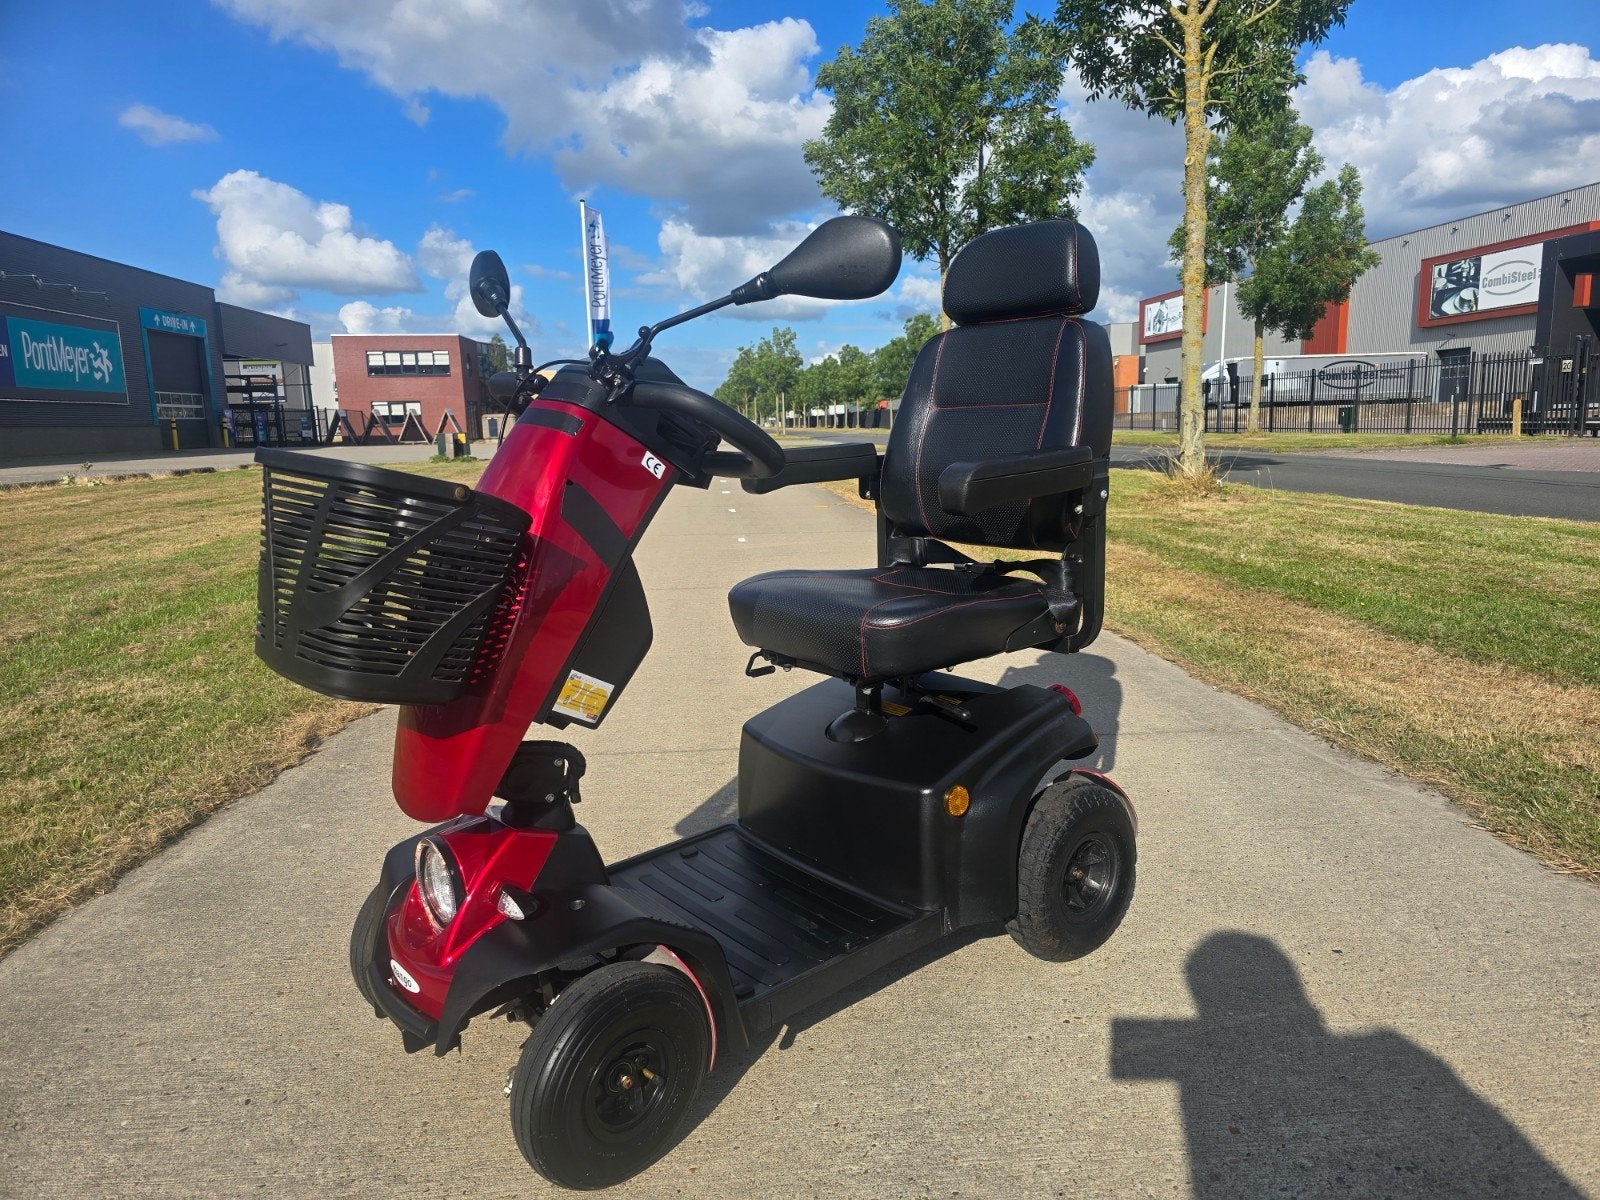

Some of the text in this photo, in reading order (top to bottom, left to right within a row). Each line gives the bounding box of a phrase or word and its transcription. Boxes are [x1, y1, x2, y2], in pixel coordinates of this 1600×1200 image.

[591, 243, 608, 308] PontMeyer
[1482, 268, 1537, 288] CombiSteel
[162, 315, 189, 330] DRIVE-IN
[21, 331, 90, 382] PontMeyer
[1318, 369, 1378, 381] CombiSteel
[646, 456, 662, 475] CE
